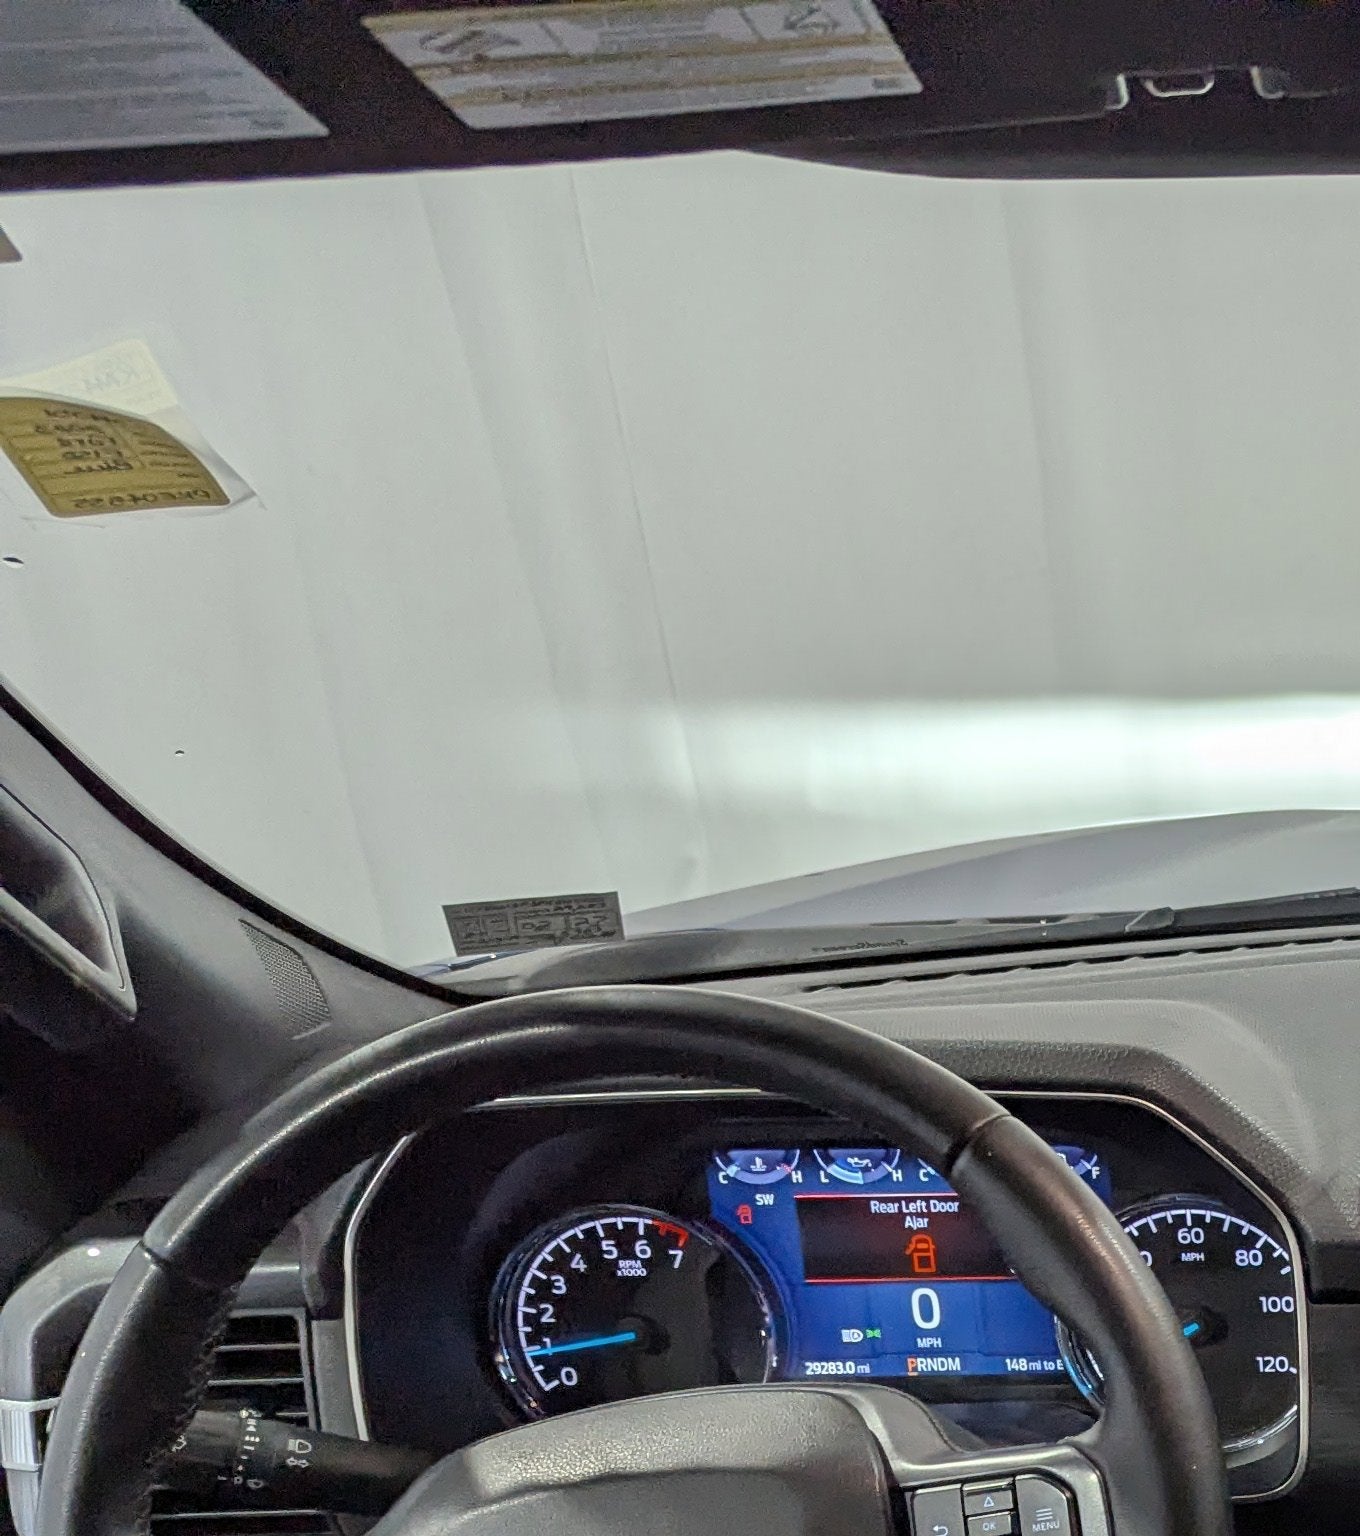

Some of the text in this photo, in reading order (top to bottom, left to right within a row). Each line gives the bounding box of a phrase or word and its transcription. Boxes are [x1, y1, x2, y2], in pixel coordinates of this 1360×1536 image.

[718, 1170, 729, 1184] C
[792, 1170, 802, 1183] H
[820, 1170, 830, 1183] L
[892, 1168, 903, 1182] H
[919, 1168, 929, 1182] C
[1092, 1166, 1101, 1180] F
[755, 1194, 775, 1207] SW
[870, 1199, 960, 1214] Rear Left Door
[904, 1216, 929, 1230] Ajar
[1177, 1227, 1205, 1244] 60
[601, 1240, 618, 1259] 5
[634, 1239, 652, 1258] 6
[570, 1253, 587, 1272] 4
[618, 1260, 642, 1268] RPM
[668, 1250, 684, 1269] 7
[1181, 1252, 1205, 1262] MPH
[1235, 1249, 1263, 1266] 80
[550, 1275, 567, 1294] 3
[911, 1287, 941, 1329] 0
[1259, 1296, 1295, 1313] 100
[539, 1303, 556, 1323] 2
[916, 1337, 942, 1348] MPH
[805, 1361, 871, 1375] 29283.0 mi
[1005, 1358, 1055, 1371] 148 mi to
[1255, 1356, 1289, 1373] 120
[560, 1367, 578, 1386] 0
[982, 1523, 997, 1532] OK
[1032, 1521, 1060, 1532] MENU
